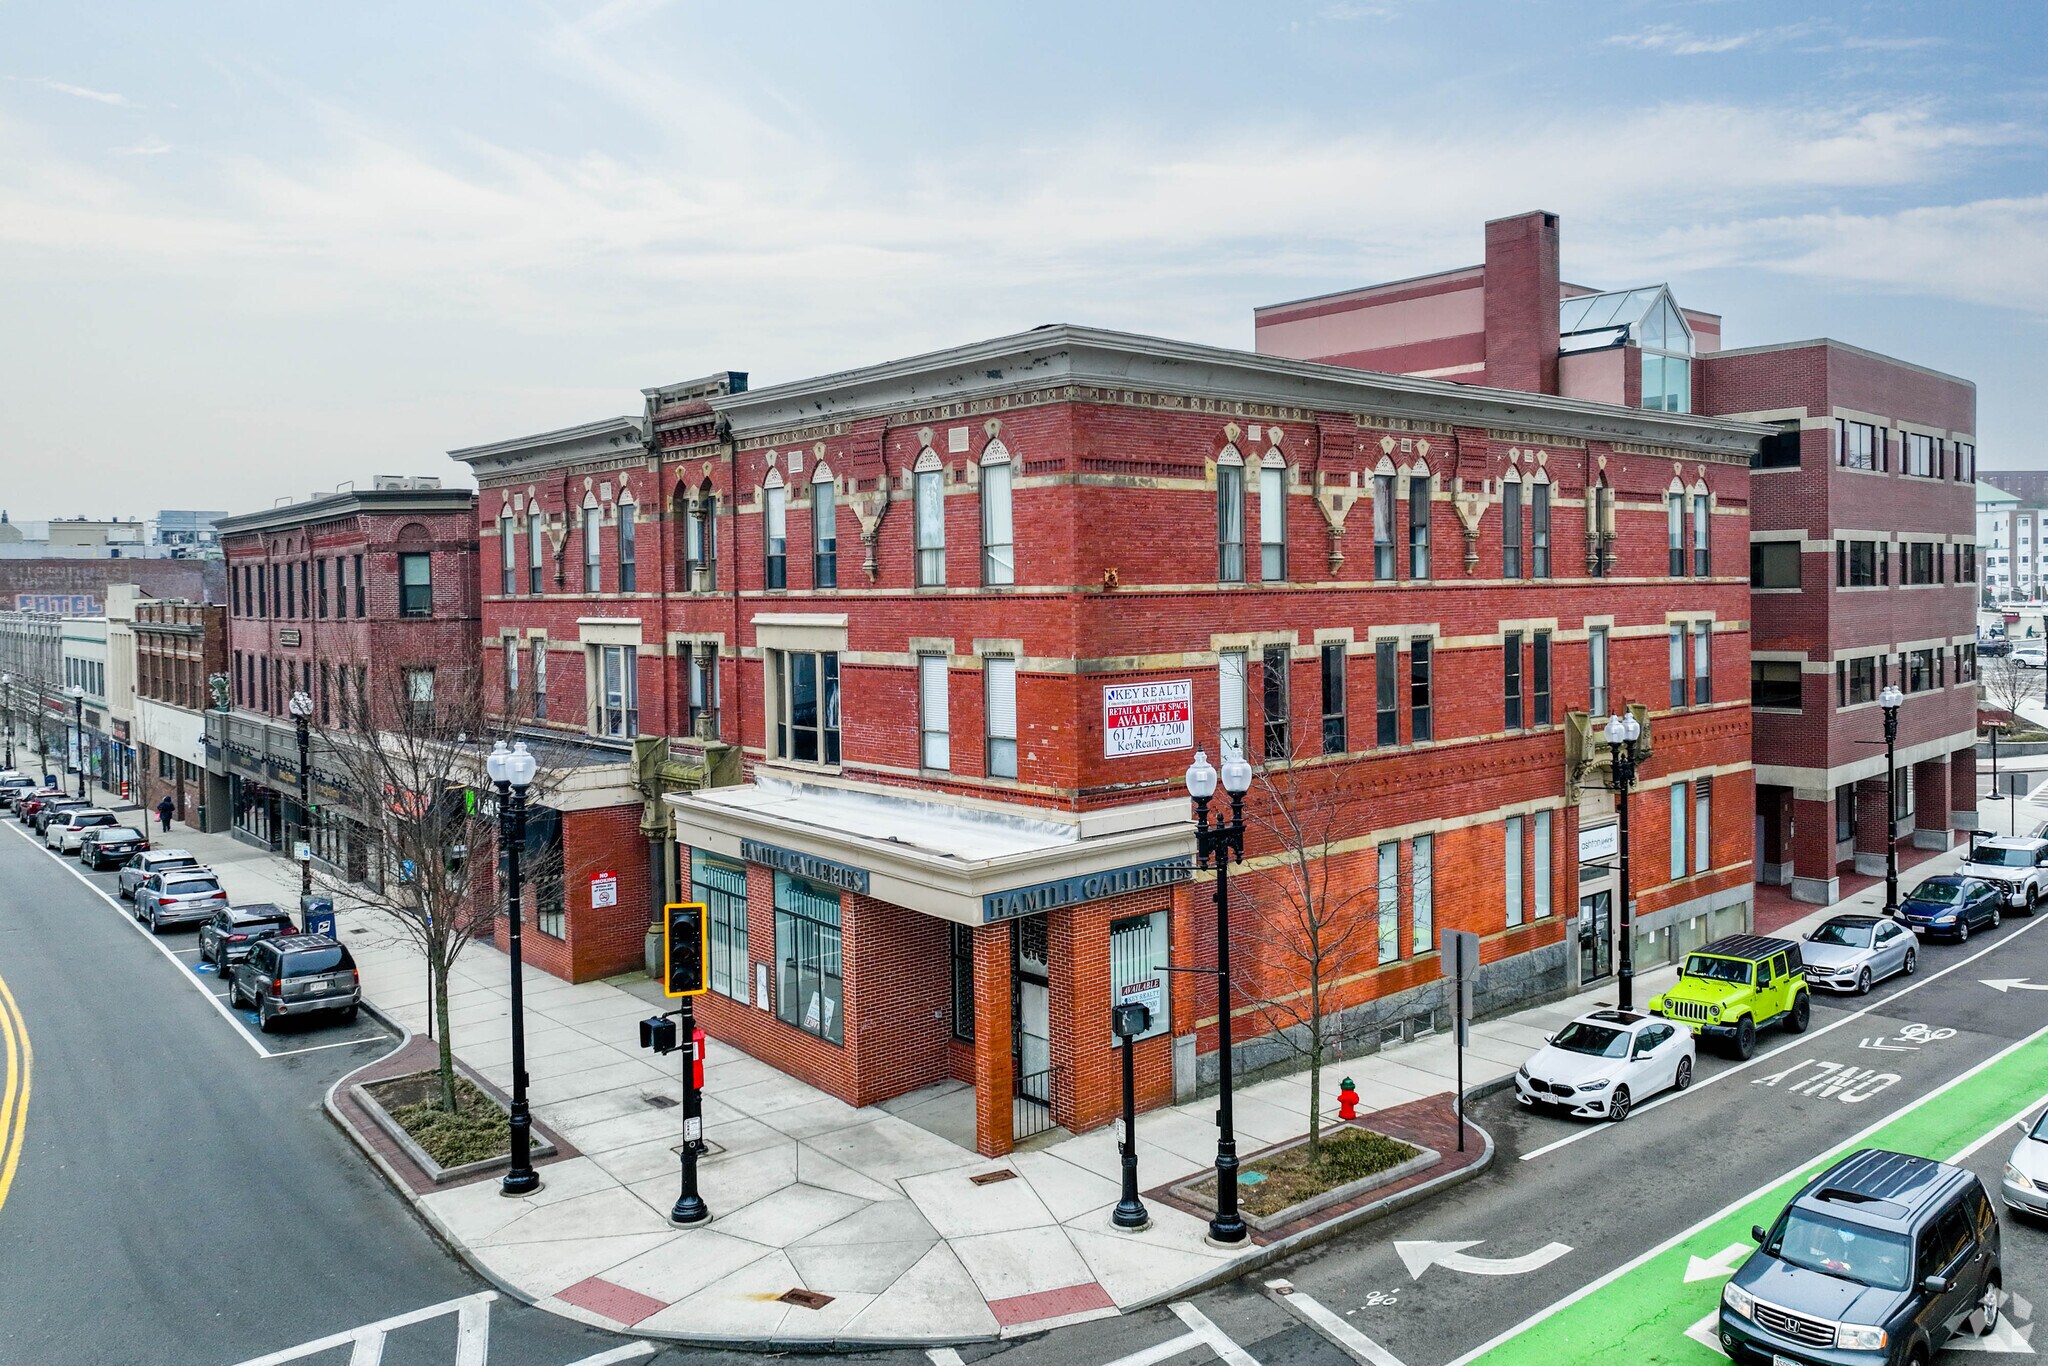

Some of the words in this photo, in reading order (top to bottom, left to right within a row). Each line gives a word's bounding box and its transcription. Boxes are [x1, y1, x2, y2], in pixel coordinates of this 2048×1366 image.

[1115, 688, 1139, 700] KEY
[1142, 684, 1187, 698] REALTY
[1109, 707, 1134, 716] RETAIL
[1135, 705, 1140, 713] &
[1143, 704, 1166, 713] OFFICE
[1168, 702, 1188, 710] SPACE
[1117, 711, 1180, 727] AVAILABLE
[1113, 722, 1185, 741] 617.472.7200
[1117, 736, 1181, 752] KeyRealty.com
[741, 842, 786, 869] HAMILL
[789, 855, 862, 890] GALLERIES
[990, 884, 1078, 919] HAMILL
[1084, 859, 1193, 898] GALLERIES
[1123, 980, 1159, 995] AVAILABLE
[1751, 1058, 1902, 1104] ONLY
